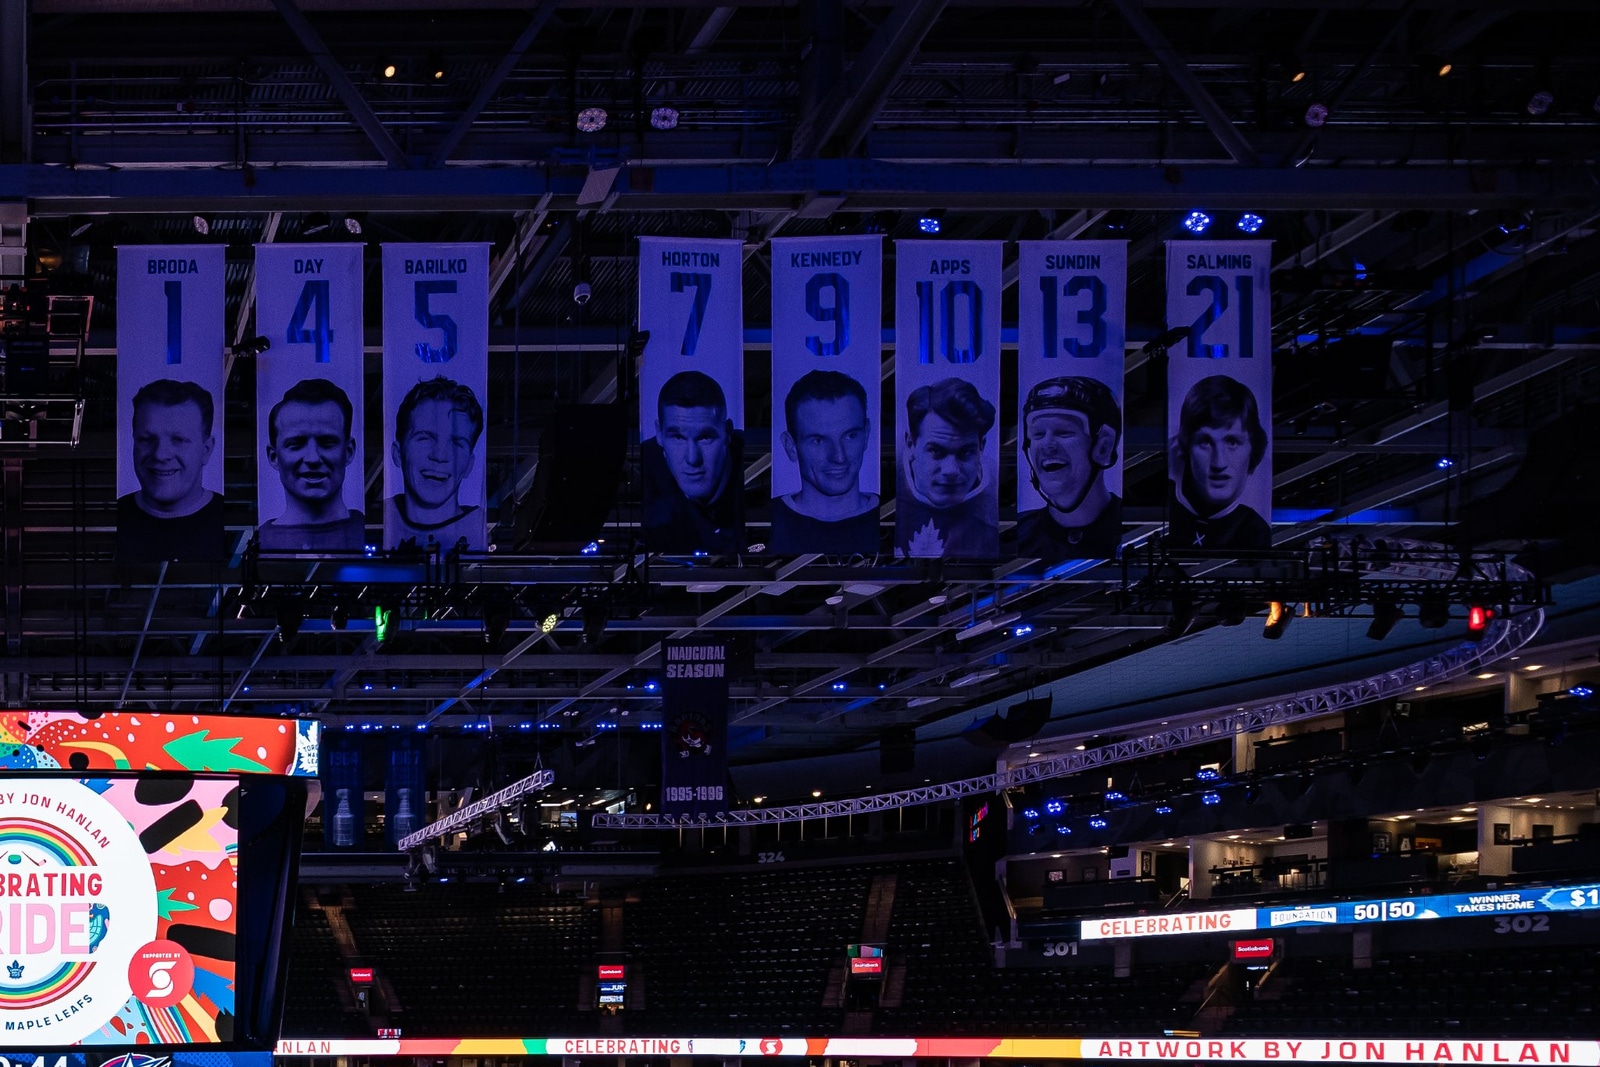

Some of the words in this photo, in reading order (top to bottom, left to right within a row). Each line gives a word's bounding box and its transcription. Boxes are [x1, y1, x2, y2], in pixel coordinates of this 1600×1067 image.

[147, 259, 199, 275] BRODA
[294, 258, 324, 274] DAY
[404, 258, 467, 275] BARILKO
[662, 251, 720, 268] HORTON
[790, 250, 863, 268] KENNEDY
[929, 259, 971, 276] APPS
[1045, 254, 1100, 270] SUNDIN
[1186, 254, 1252, 270] SALMING
[164, 280, 182, 365] 1
[287, 280, 334, 363] 4
[414, 280, 458, 363] 5
[670, 272, 712, 356] 7
[805, 273, 850, 356] 9
[916, 280, 983, 364] 10
[1040, 275, 1107, 359] 13
[1185, 275, 1253, 358] 21
[667, 646, 726, 661] INAUGURAL
[666, 664, 725, 678] SEASON
[665, 786, 723, 801] 1995-1996
[22, 793, 52, 809] JON
[55, 802, 111, 850] HANLAN
[757, 851, 785, 864] 324
[1455, 902, 1498, 912] TAKES
[1501, 900, 1535, 911] HOME
[1468, 894, 1521, 905] WINNER
[1353, 901, 1416, 922] 50|50
[1100, 913, 1232, 936] CELEBRATING
[1494, 914, 1550, 934] 302
[1043, 941, 1078, 957] 301
[1237, 944, 1270, 952] Scotiabank
[5, 1017, 52, 1030] MAPLE
[55, 994, 94, 1022] LEAFS
[564, 1039, 681, 1055] CELEBRATING
[1098, 1041, 1247, 1059] ARTWORK
[1264, 1041, 1303, 1059] BY
[1320, 1041, 1386, 1060] JON
[1405, 1042, 1571, 1063] HANLAN
